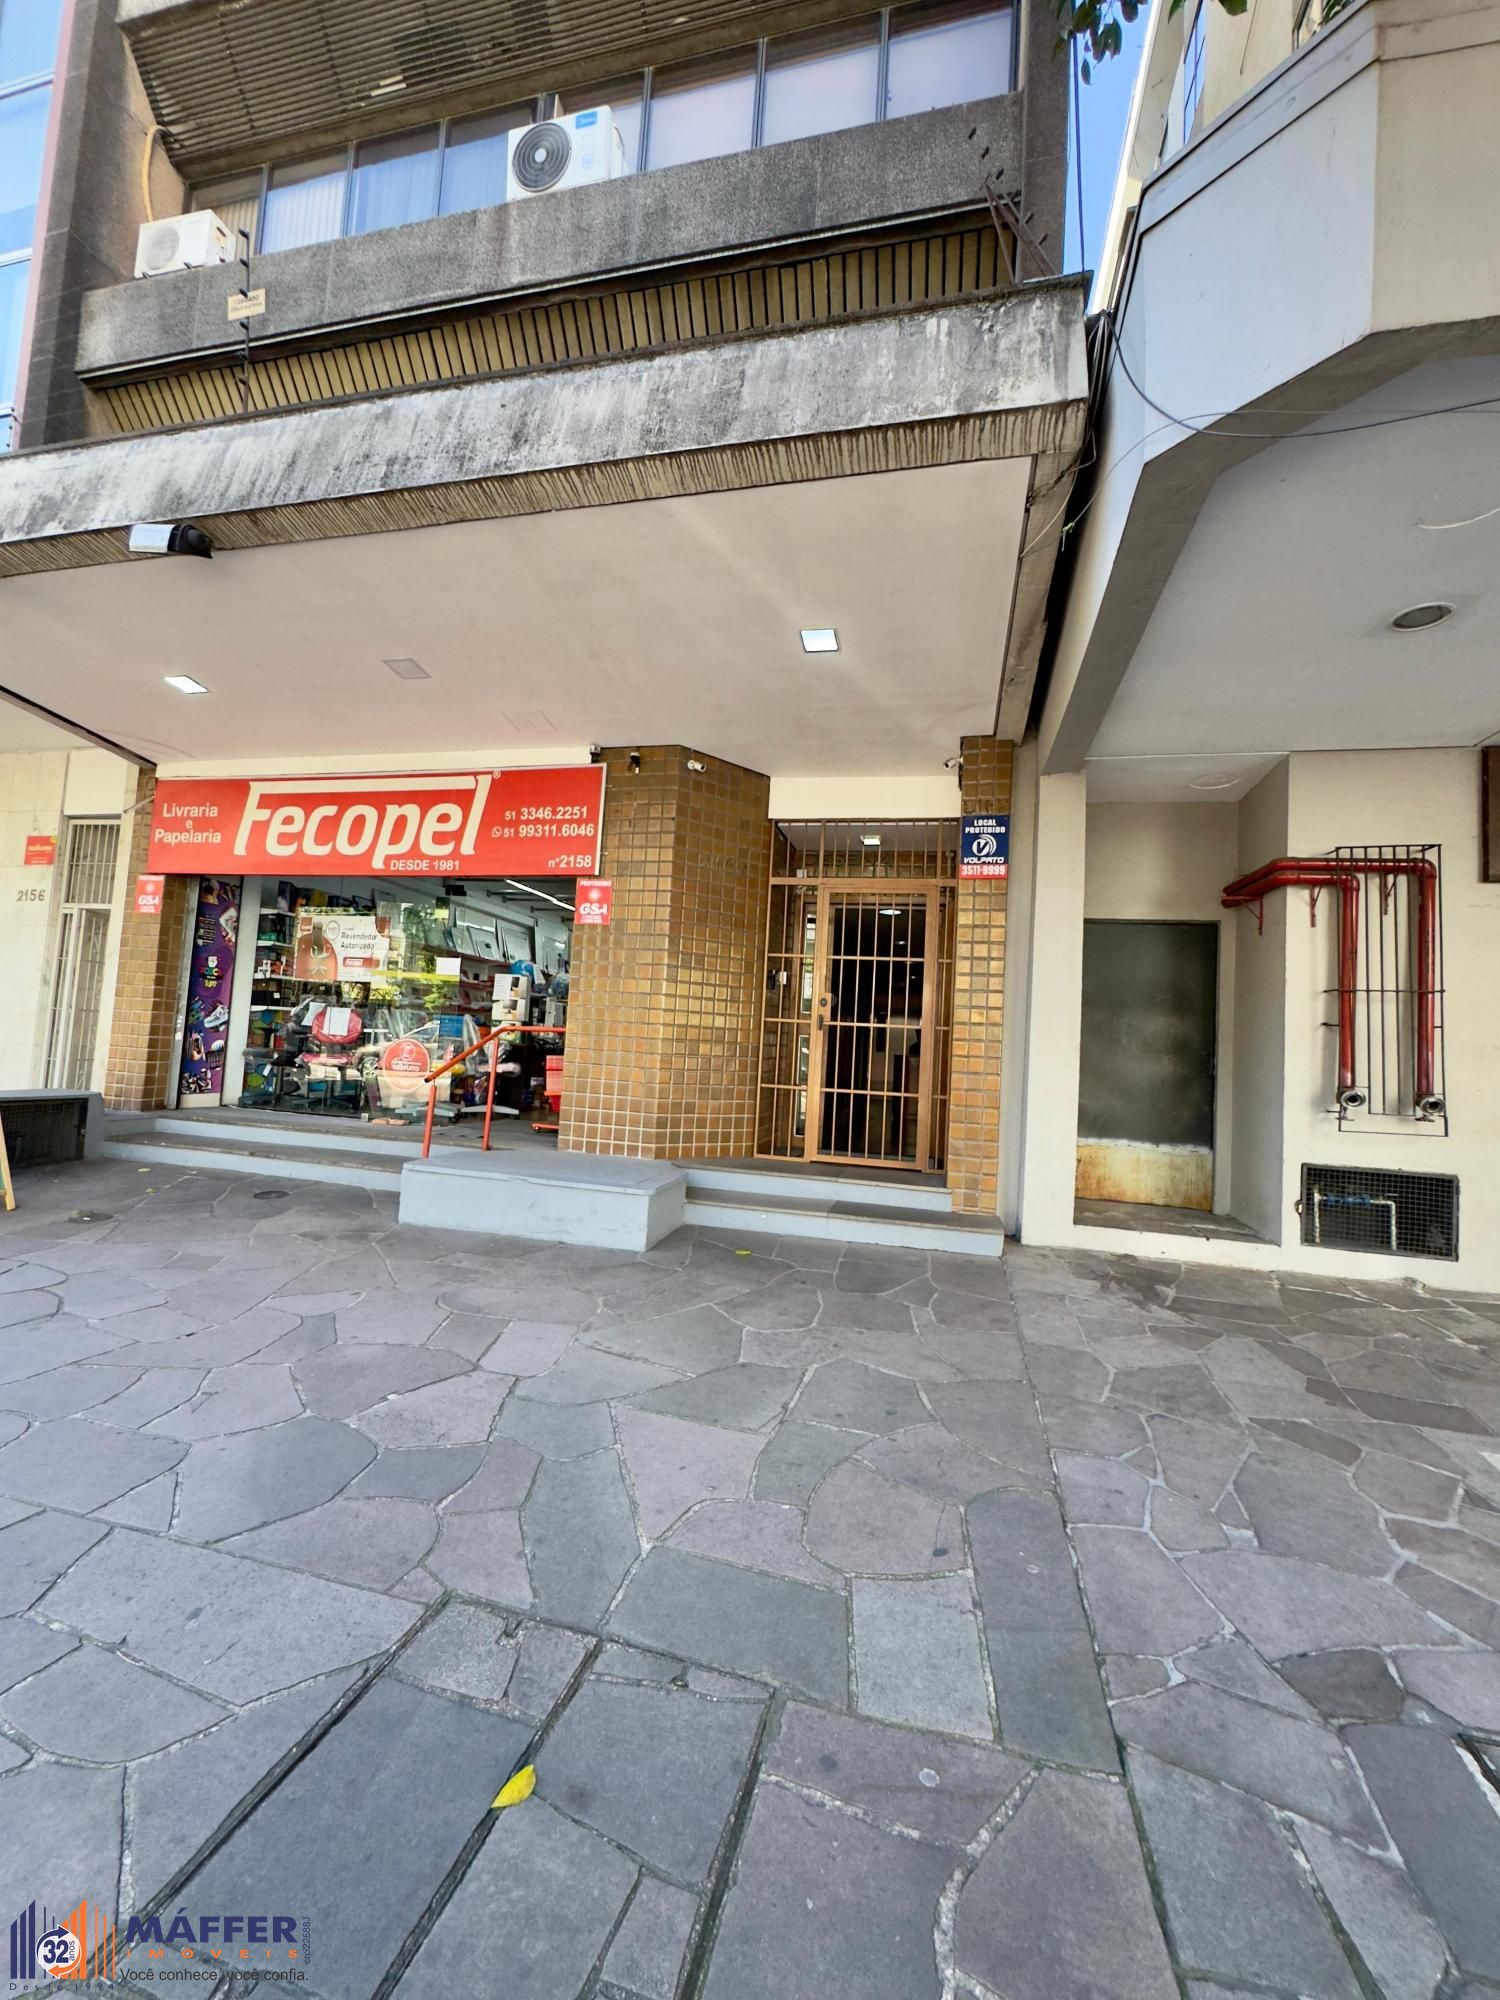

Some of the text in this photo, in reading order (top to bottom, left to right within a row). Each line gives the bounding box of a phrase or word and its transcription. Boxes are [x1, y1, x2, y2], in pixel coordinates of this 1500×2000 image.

[163, 803, 218, 817] Livraria
[505, 806, 588, 820] 51 3346.2251
[186, 820, 192, 829] e
[234, 774, 492, 869] Fecopel
[503, 824, 594, 837] 51 99311.6046
[154, 829, 221, 846] Papelaria
[390, 859, 460, 871] DESDE 1981
[962, 865, 1006, 875] 3511-9999
[16, 889, 46, 902] 2156
[340, 942, 375, 950] Autorizado
